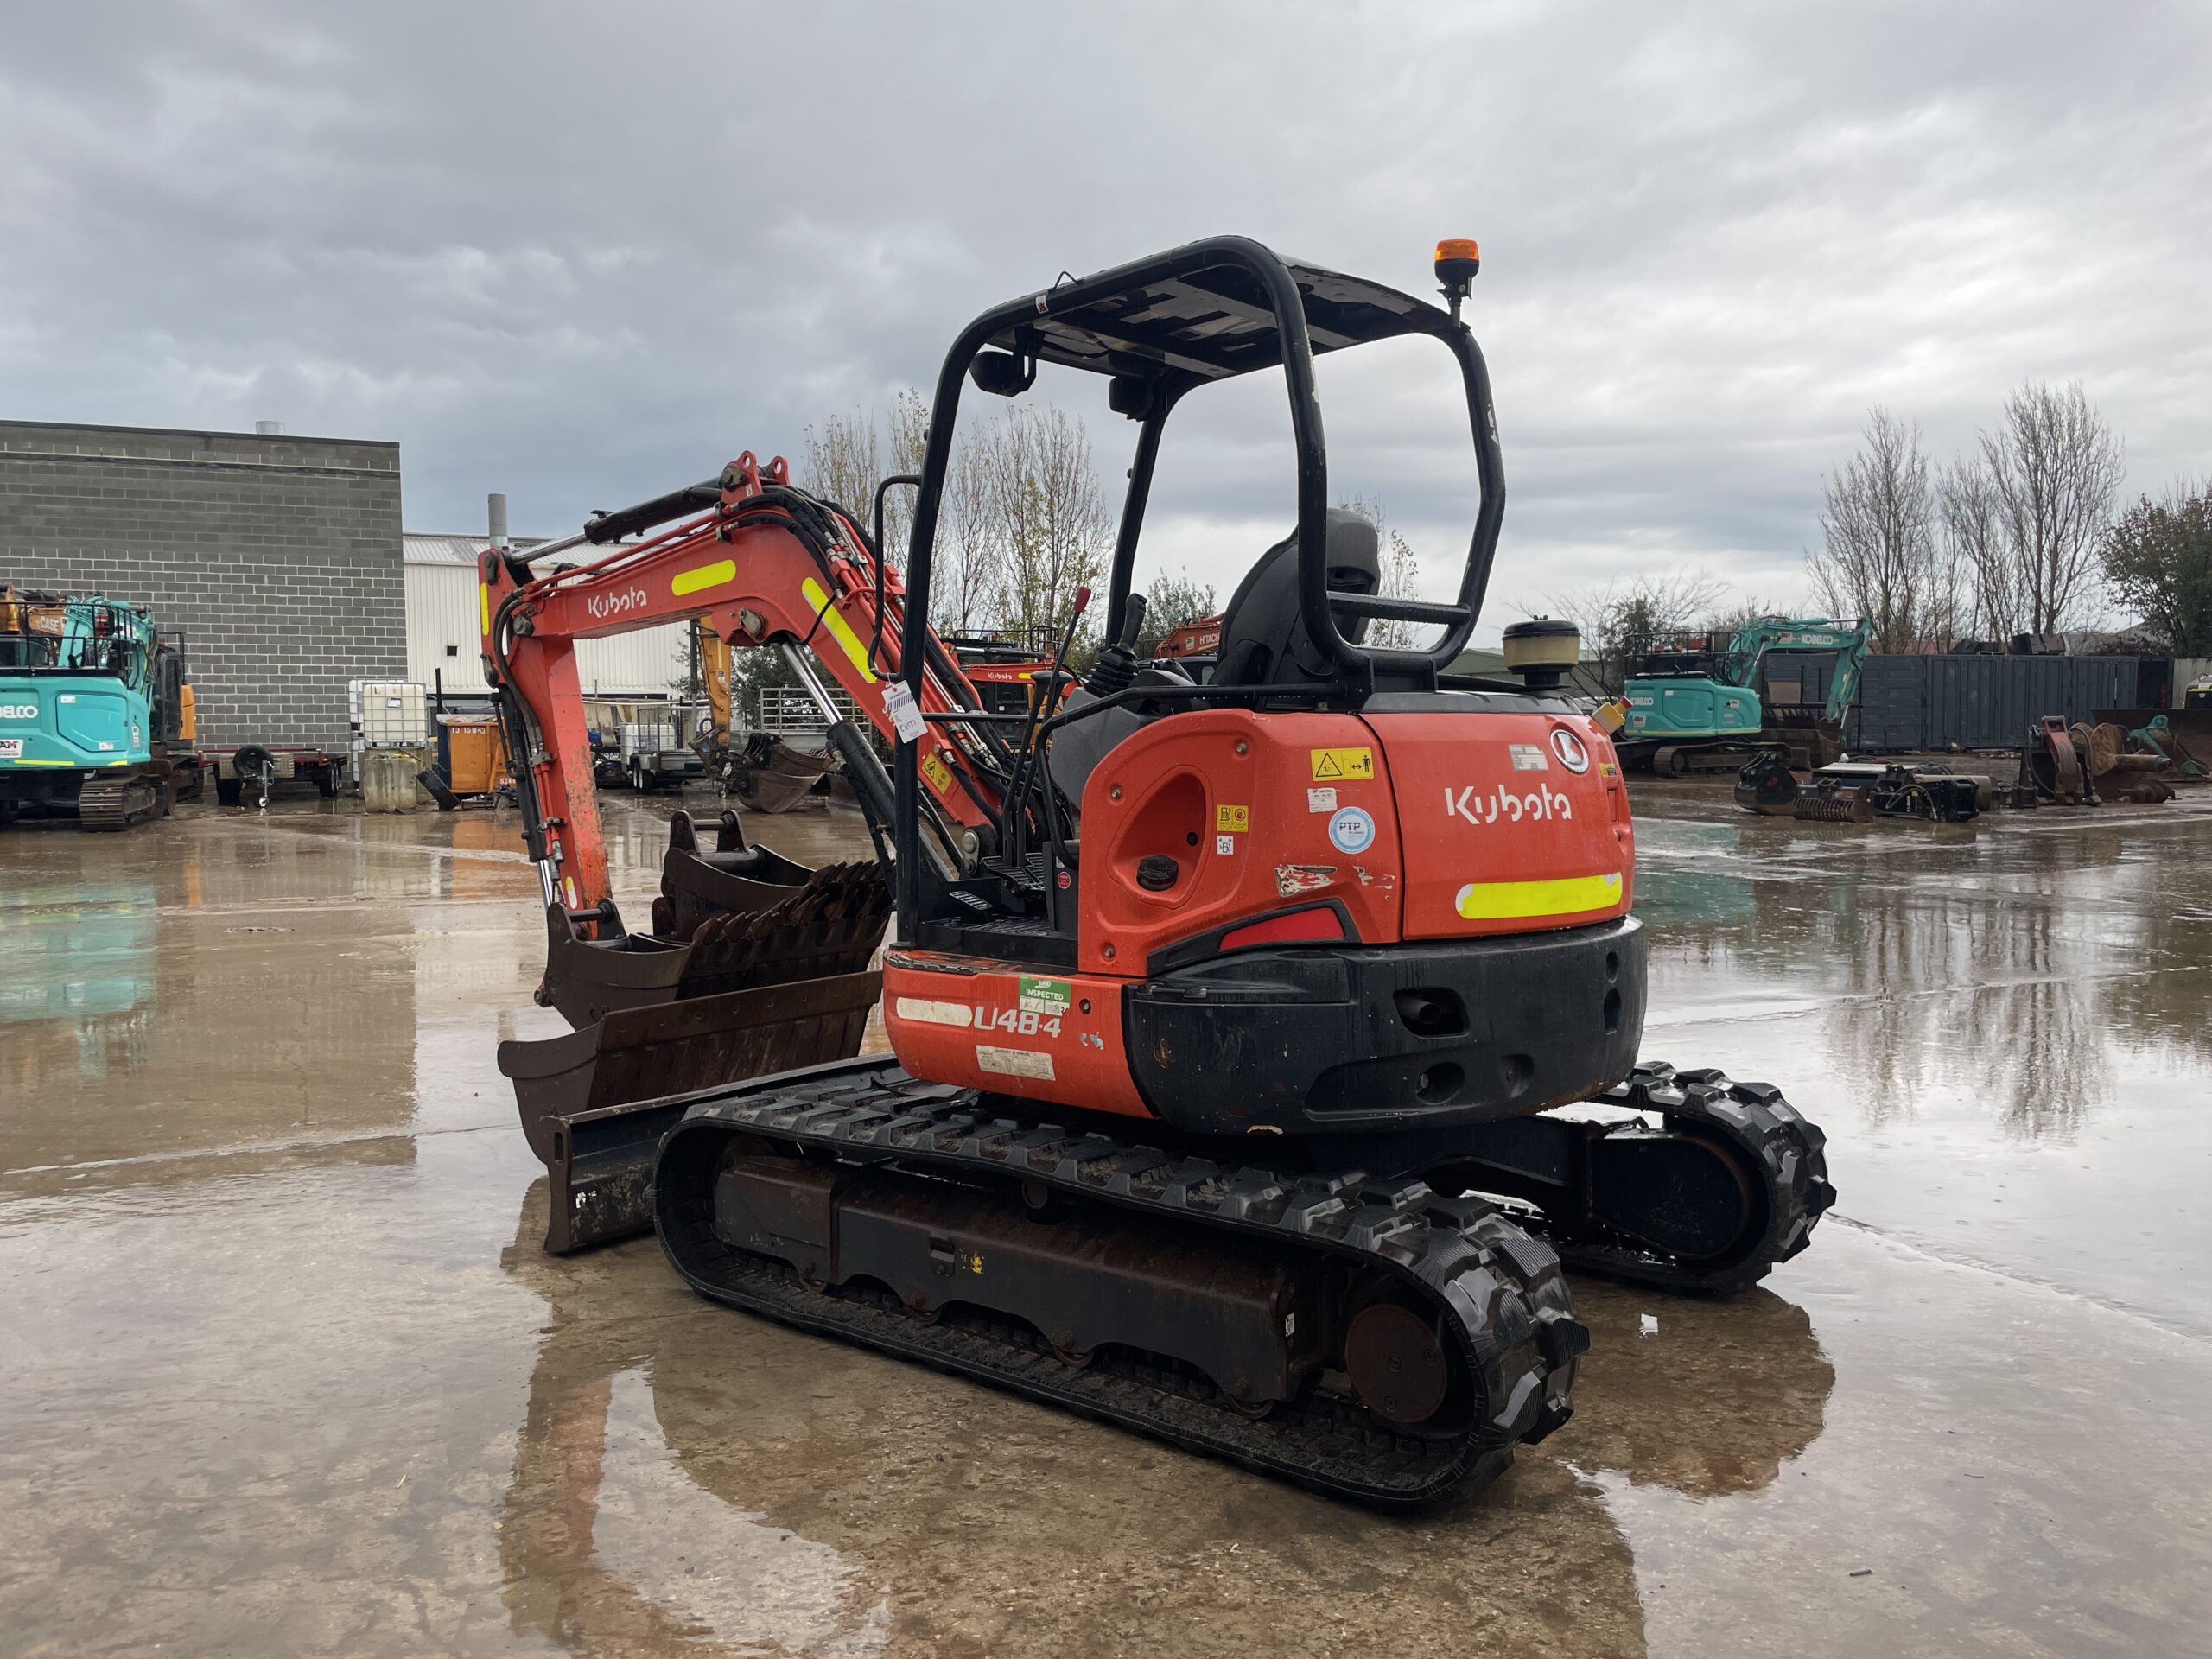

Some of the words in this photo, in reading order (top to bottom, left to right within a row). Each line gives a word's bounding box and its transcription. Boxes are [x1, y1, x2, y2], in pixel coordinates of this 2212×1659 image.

[588, 586, 647, 618] Kubota
[41, 615, 60, 632] CASE
[1801, 634, 1834, 645] KOBELCO
[987, 671, 1013, 680] Kubota
[1444, 782, 1573, 825] Kubota
[1338, 822, 1361, 831] PTP
[1026, 988, 1064, 1001] INSPECTED
[973, 1005, 1062, 1039] U48-4
